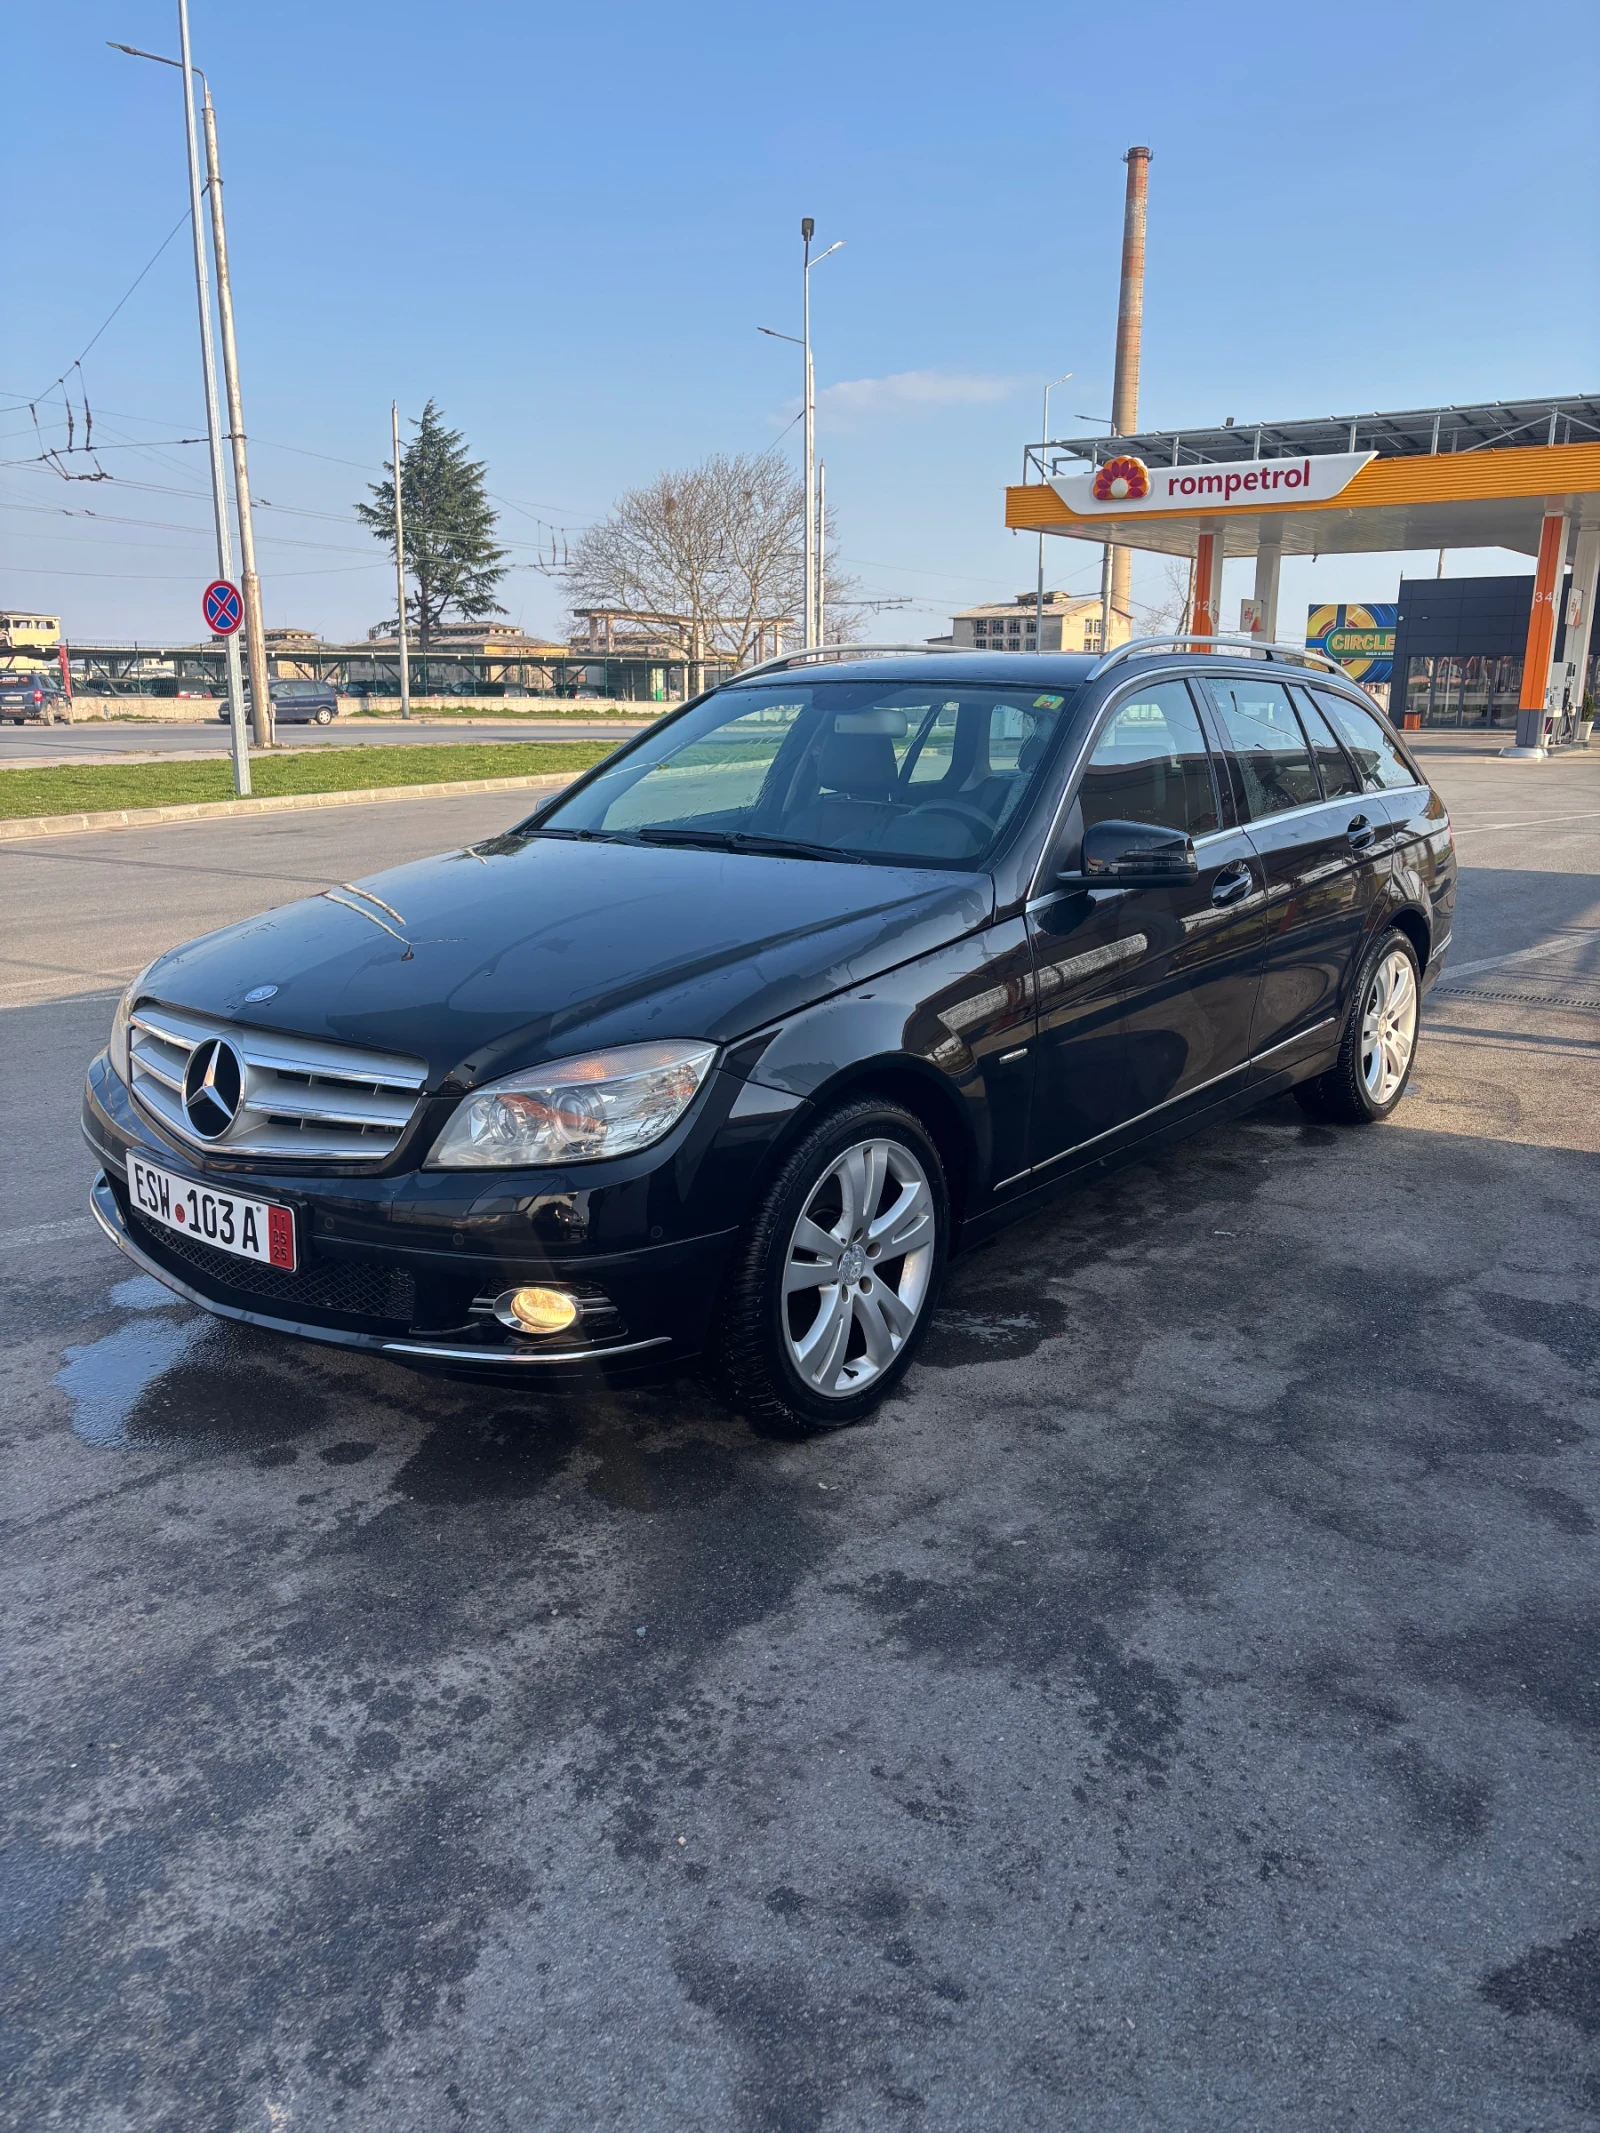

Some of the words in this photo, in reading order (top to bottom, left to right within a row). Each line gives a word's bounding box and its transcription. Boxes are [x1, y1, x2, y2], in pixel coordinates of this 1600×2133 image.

[1168, 459, 1311, 501] rompetrol
[1331, 633, 1396, 651] CIRCLE
[134, 1162, 171, 1220] ESW
[273, 1228, 288, 1246] 05
[273, 1244, 288, 1262] 25
